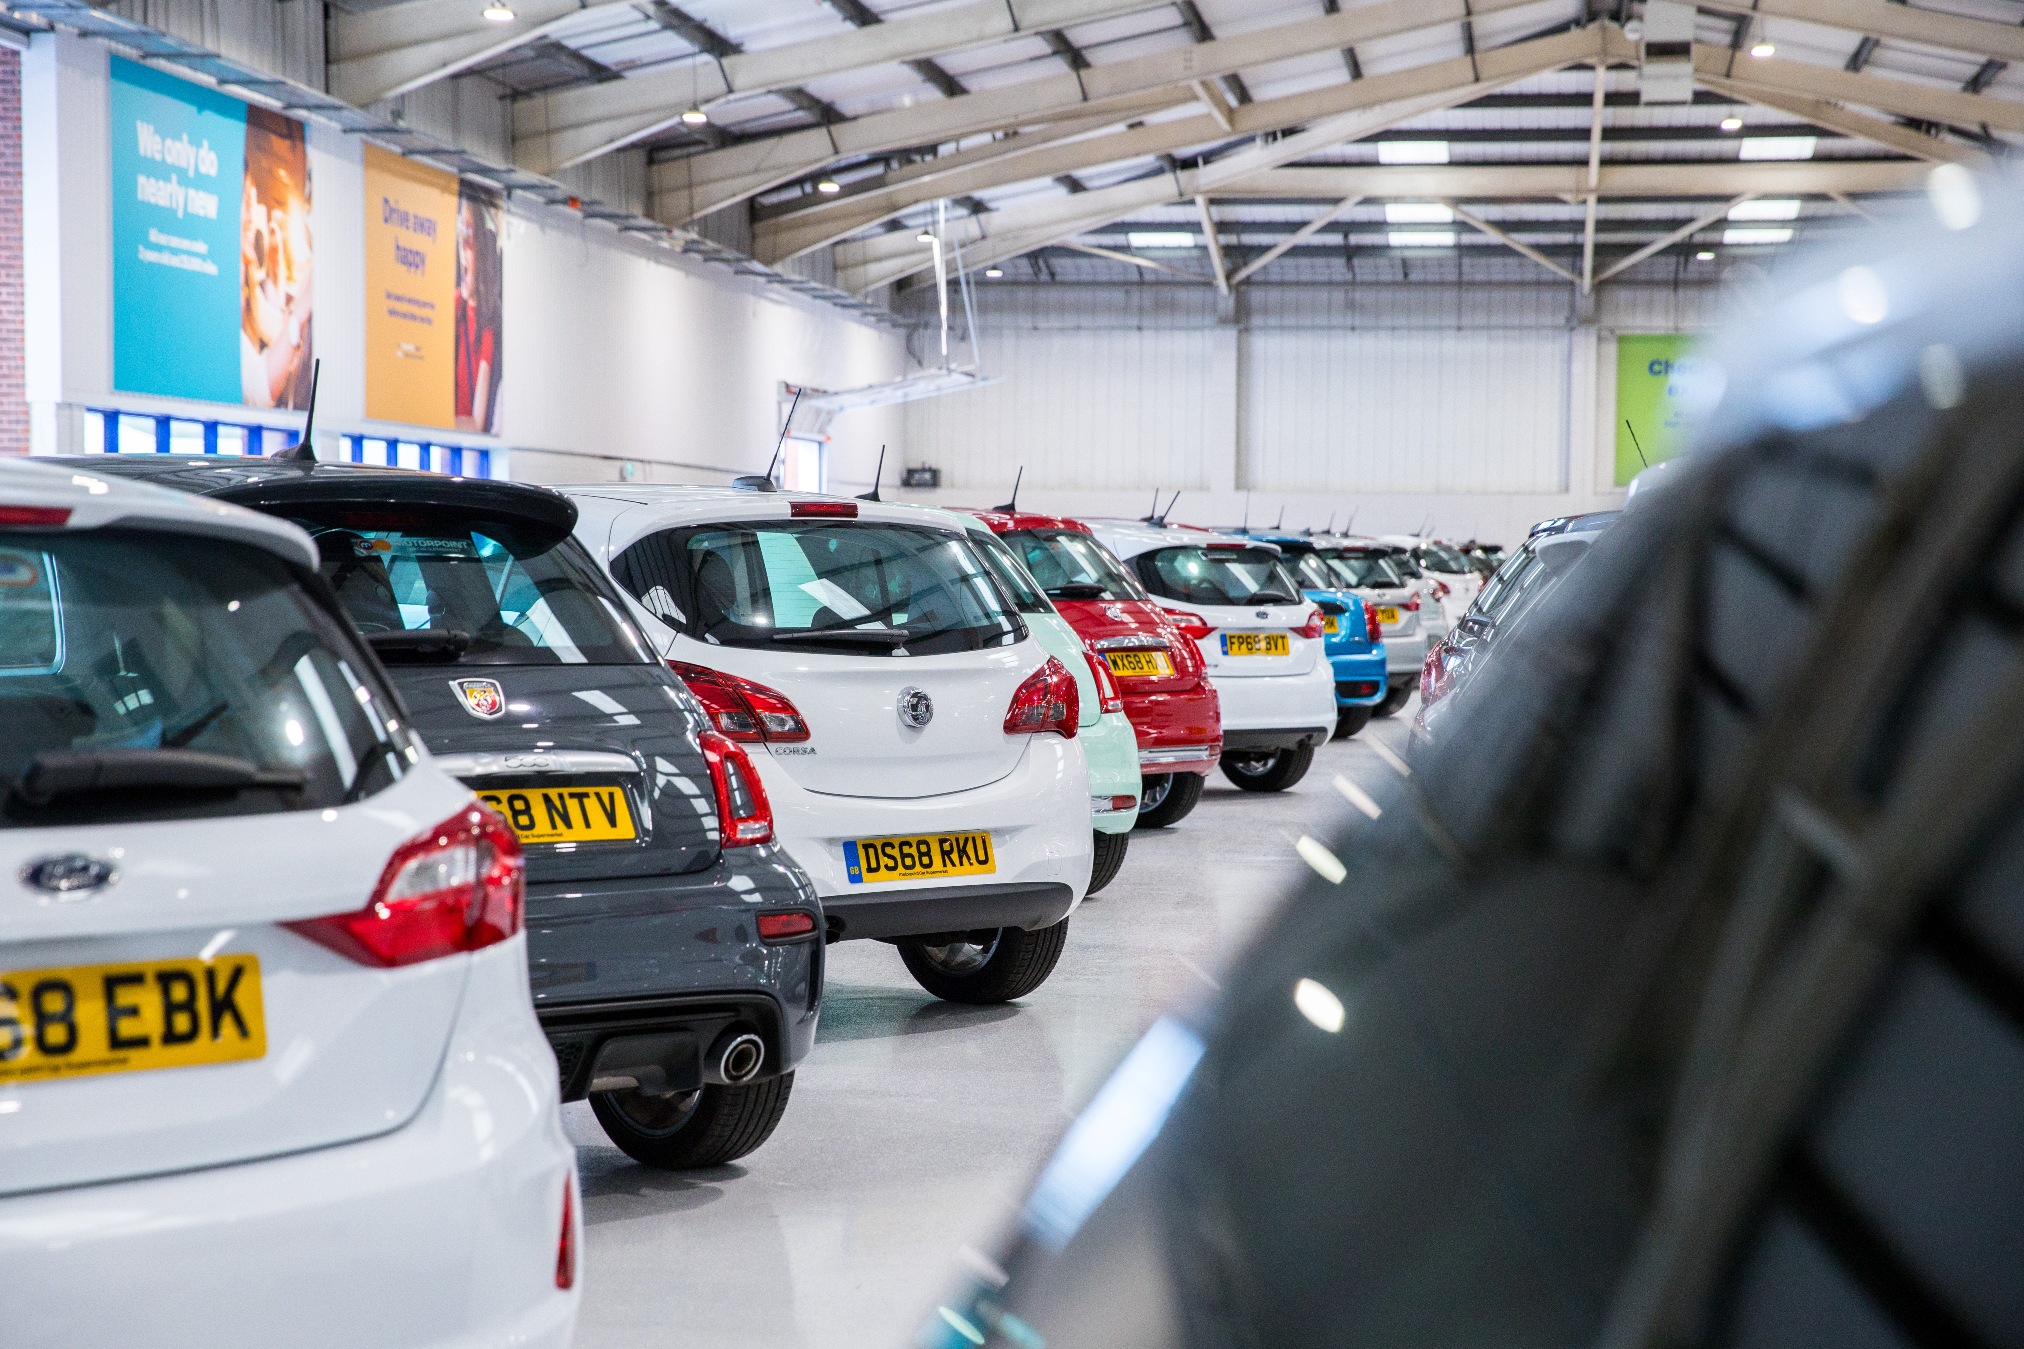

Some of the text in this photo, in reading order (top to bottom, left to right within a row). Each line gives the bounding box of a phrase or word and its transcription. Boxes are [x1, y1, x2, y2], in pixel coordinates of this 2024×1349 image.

[136, 120, 218, 178] We only do
[137, 174, 218, 219] nearly new
[383, 196, 437, 244] Drive away
[394, 236, 426, 276] happy
[1109, 654, 1145, 671] WX68
[1264, 635, 1286, 651] BVT
[775, 746, 818, 756] CORSA
[541, 791, 618, 831] NTV
[850, 866, 860, 875] GB
[861, 835, 990, 874] DS68 RKU
[101, 964, 251, 1051] EBK
